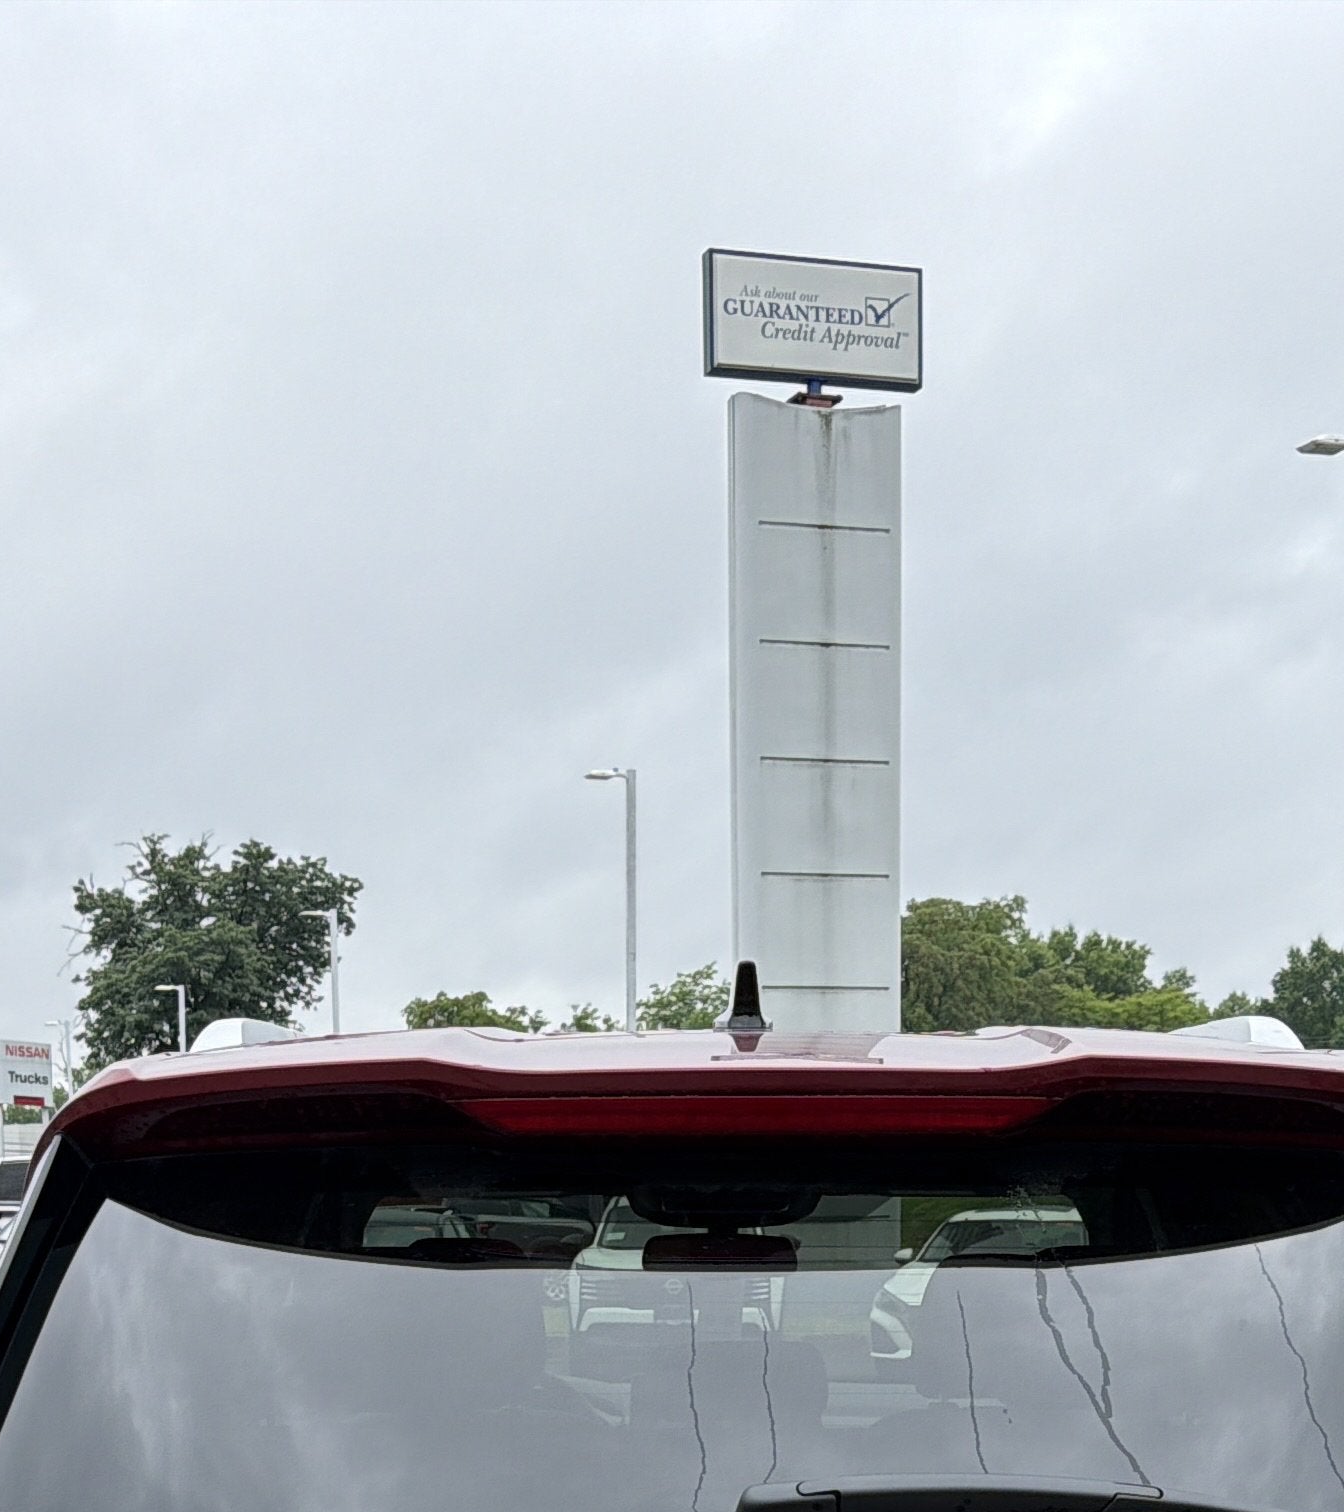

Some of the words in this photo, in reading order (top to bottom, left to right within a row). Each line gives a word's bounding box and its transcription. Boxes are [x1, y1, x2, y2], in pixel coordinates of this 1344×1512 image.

[740, 285, 761, 298] Ask
[764, 287, 796, 302] about
[799, 293, 819, 303] our
[723, 298, 863, 326] GUARANTEED
[761, 321, 816, 342] Credit
[5, 1044, 49, 1059] NISSAN
[8, 1071, 48, 1085] Trucks
